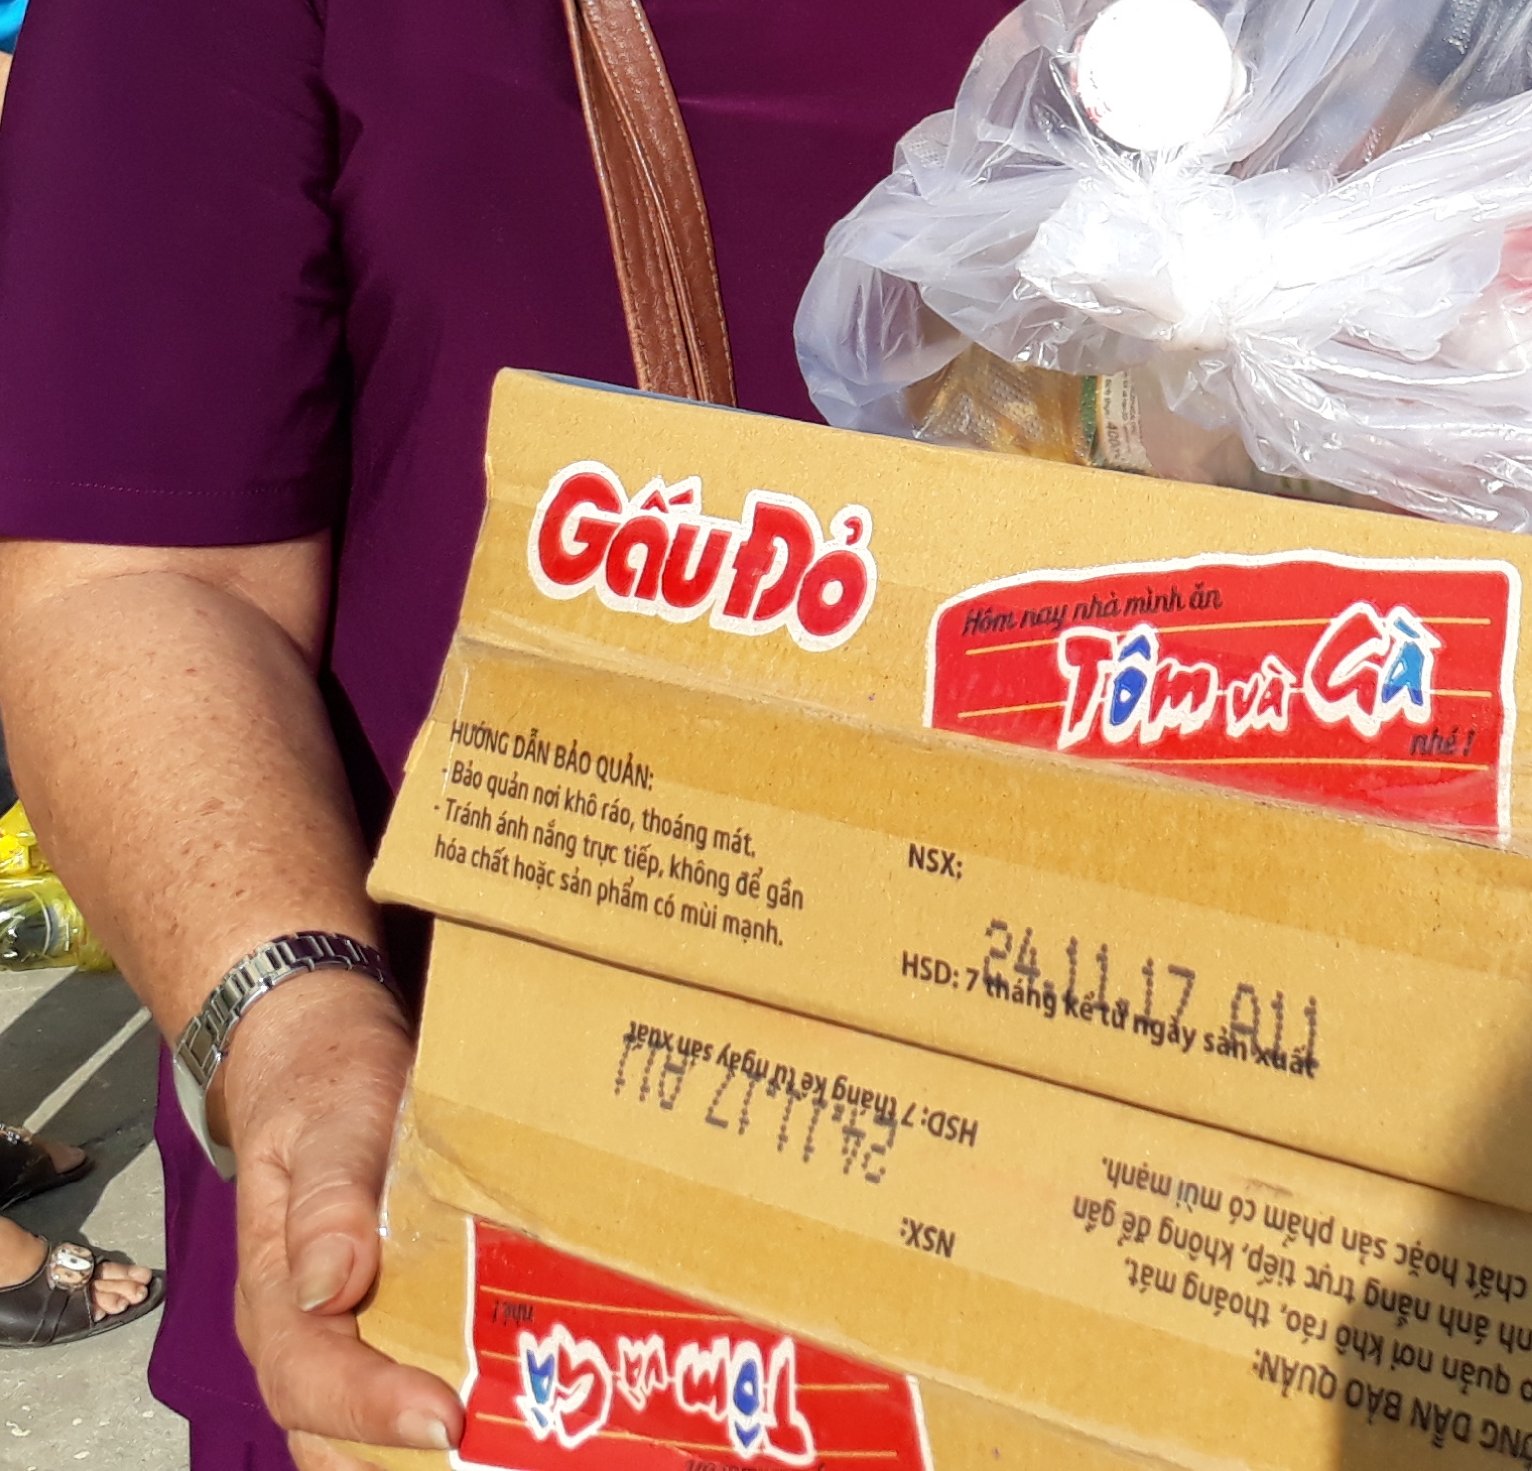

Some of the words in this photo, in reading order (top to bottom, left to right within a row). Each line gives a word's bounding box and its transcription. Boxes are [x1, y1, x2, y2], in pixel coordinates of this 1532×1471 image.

[962, 607, 1016, 636] Hôm
[1019, 603, 1067, 629] nay
[1073, 592, 1121, 621] nhà
[1123, 586, 1186, 617] mình
[1189, 581, 1223, 610] ăn
[1058, 624, 1219, 750] Tôm
[1304, 600, 1445, 737] Gà
[450, 720, 510, 756] HƯỚNG
[512, 727, 550, 766] DẪN
[553, 738, 591, 775] BẢO
[596, 752, 654, 792] QUẢN:
[451, 760, 483, 790] Bảo
[486, 770, 529, 799] quản
[533, 784, 561, 809] nơi
[564, 787, 598, 817] khô
[601, 797, 636, 834] ráo,
[641, 807, 708, 851] thoáng
[713, 827, 756, 858] mát.
[445, 797, 492, 832] Tránh
[496, 810, 529, 841] ánh
[533, 818, 578, 859] nắng
[582, 834, 619, 867] trực
[624, 842, 664, 879] tiếp,
[669, 853, 730, 898] không
[735, 866, 763, 899] để
[766, 877, 804, 910] gần
[908, 842, 963, 880] NSX:
[434, 833, 467, 863] hóa
[471, 845, 510, 877] chất
[513, 854, 556, 890] hoặc
[560, 866, 592, 897] sản
[596, 875, 649, 913] phẩm
[654, 893, 675, 919] có
[680, 901, 718, 929] mùi
[722, 914, 784, 947] mạnh.
[902, 949, 960, 989] HSD:
[965, 966, 980, 992] 7
[985, 971, 1057, 1019] tháng
[1203, 1025, 1248, 1061] sản
[1254, 1042, 1317, 1079] xuất
[677, 1035, 714, 1067] sản
[832, 1074, 898, 1124] tháng
[900, 1102, 917, 1128] 7
[921, 1105, 979, 1147] HSD:
[1102, 1156, 1173, 1197] mạnh.
[1175, 1179, 1223, 1214] mùi
[1072, 1195, 1117, 1233] gần
[1117, 1210, 1152, 1247] để
[1229, 1195, 1257, 1225] có
[1263, 1204, 1335, 1247] phẩm
[900, 1216, 956, 1259] NSX:
[1158, 1215, 1235, 1271] không
[1341, 1226, 1388, 1266] sản
[1123, 1256, 1178, 1294] mát.
[1241, 1242, 1296, 1287] tiếp,
[1303, 1261, 1356, 1305] trực
[1394, 1240, 1460, 1288] hoặc
[1465, 1261, 1528, 1303] chất
[1182, 1270, 1270, 1328] thoáng
[1364, 1277, 1431, 1327] nắng
[1280, 1303, 1328, 1344] ráo,
[1335, 1324, 1385, 1366] khô
[1439, 1303, 1491, 1346] ánh
[1253, 1347, 1338, 1400] QUẢN:
[1391, 1337, 1434, 1372] nơi
[1442, 1354, 1511, 1396] quản
[515, 1323, 613, 1449] Gà
[675, 1335, 817, 1466] Tôm
[1344, 1378, 1403, 1425] BẢO
[1411, 1396, 1472, 1449] DẪN
